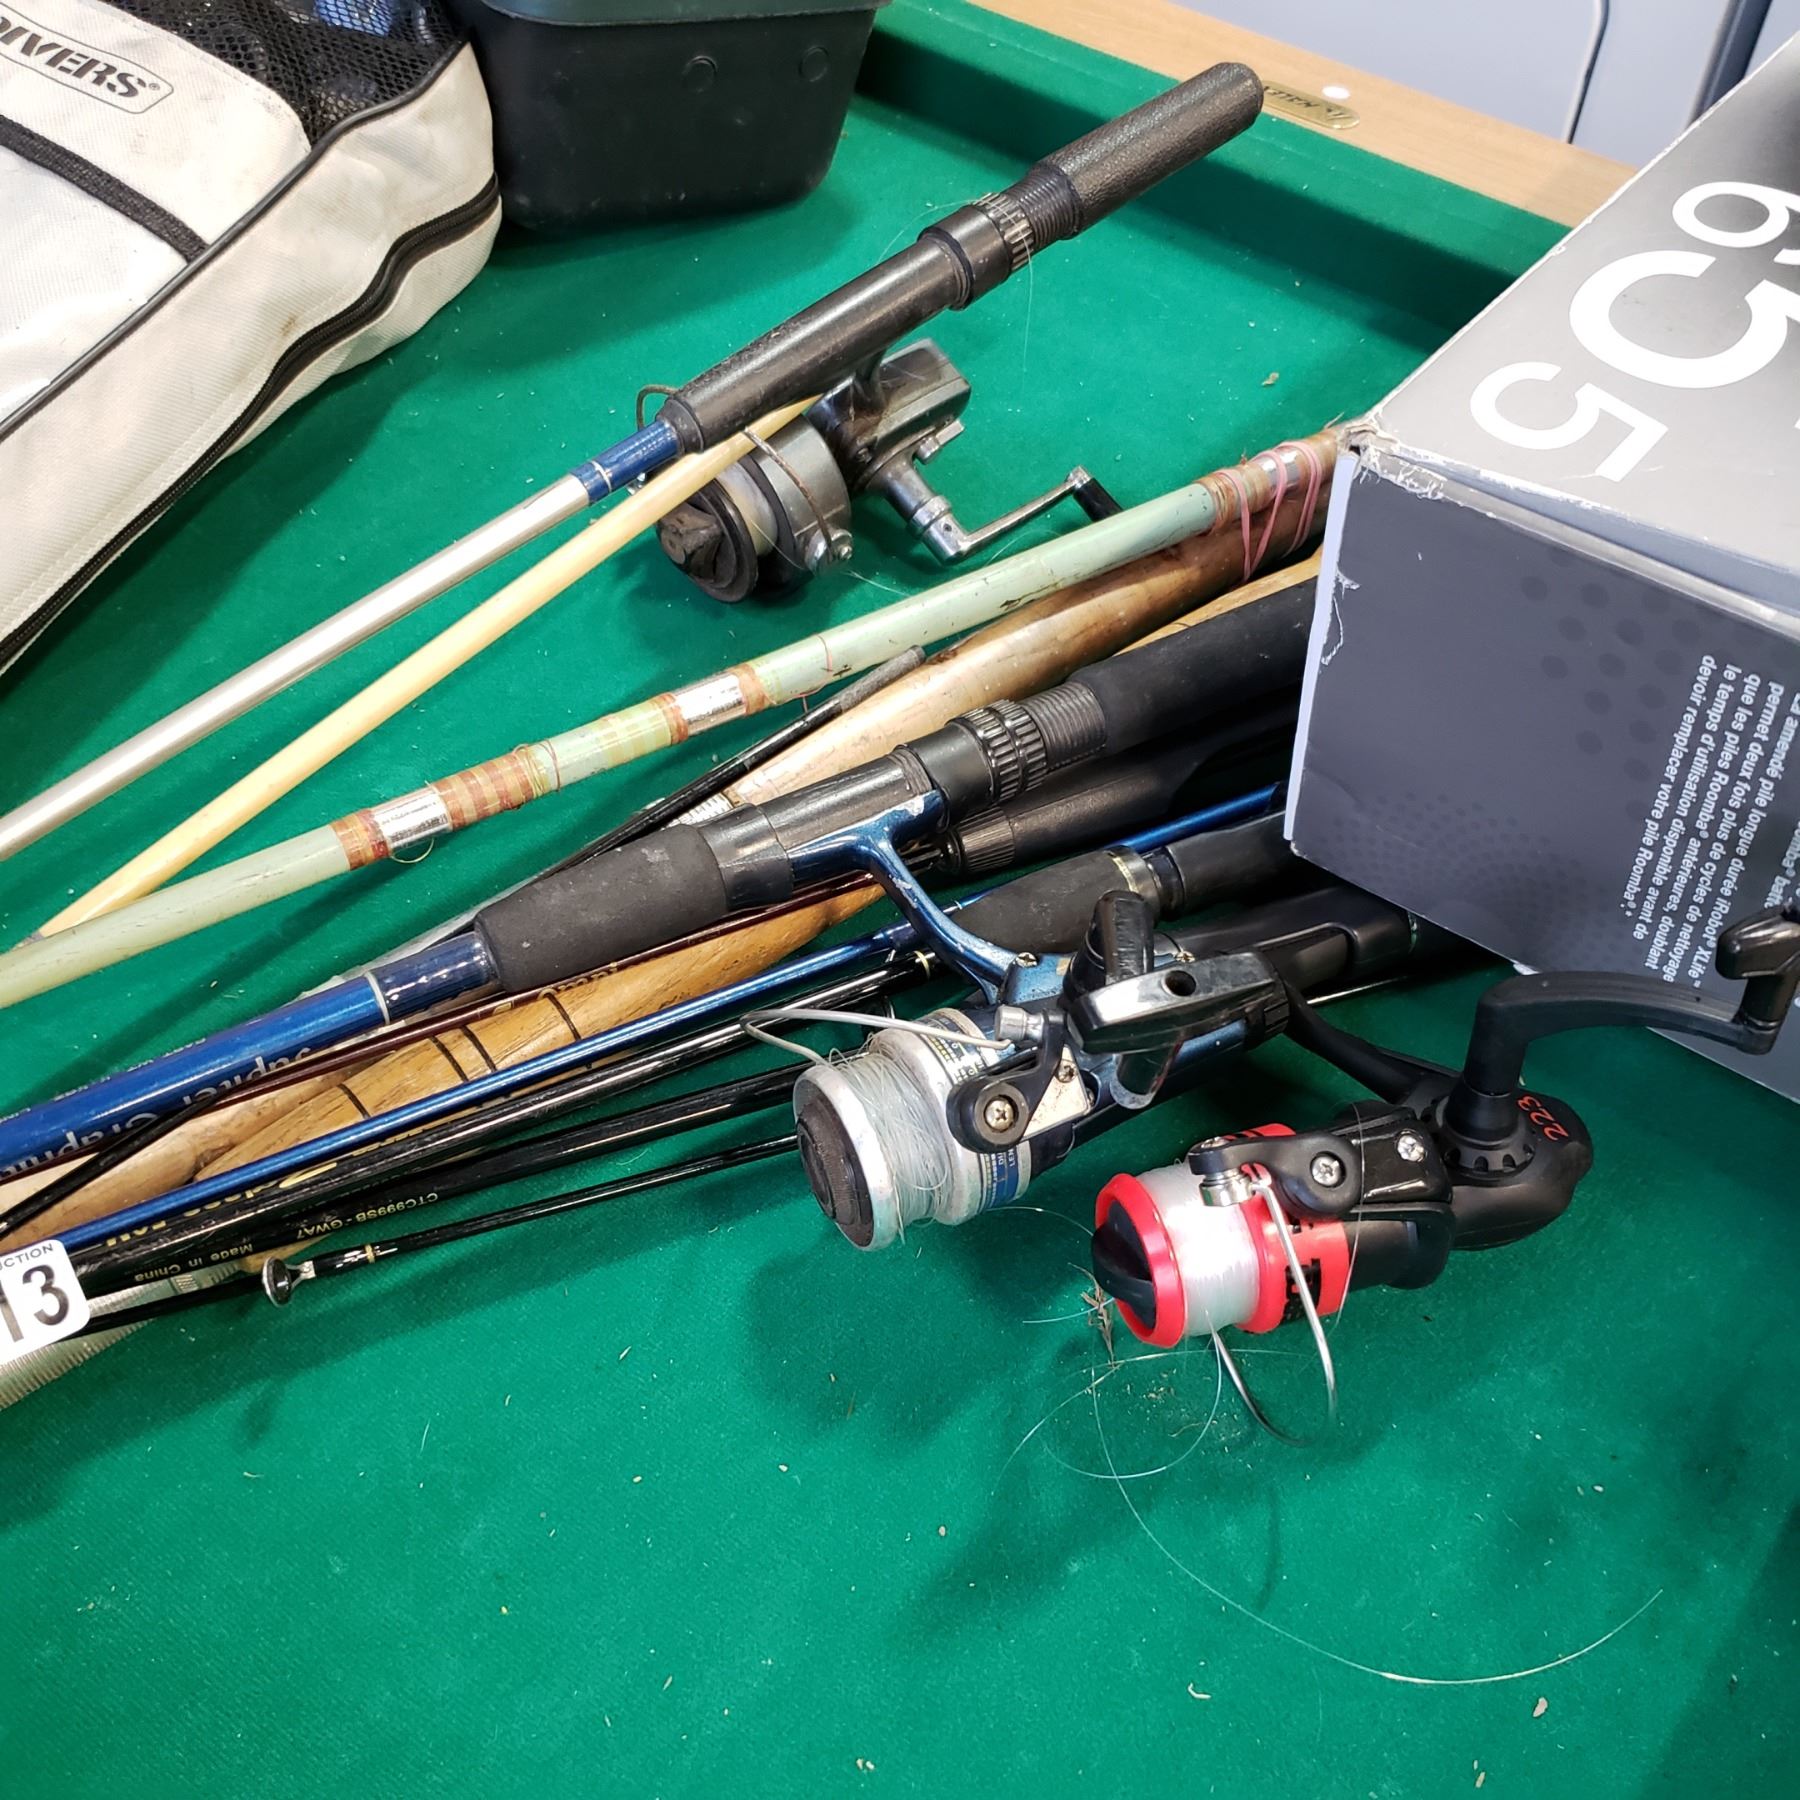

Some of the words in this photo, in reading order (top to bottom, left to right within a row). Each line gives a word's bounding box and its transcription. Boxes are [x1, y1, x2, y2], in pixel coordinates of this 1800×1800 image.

[1690, 655, 1717, 706] devoir
[1723, 664, 1742, 680] le
[1741, 674, 1761, 705] que
[1705, 683, 1734, 732] temps
[1731, 707, 1753, 731] les
[1753, 682, 1784, 741] permet
[1664, 706, 1697, 782] remplacer
[1717, 731, 1740, 769] piles
[1739, 742, 1764, 780] deux
[1766, 716, 1798, 779] amendé
[1651, 784, 1672, 819] votre
[1728, 780, 1751, 808] fois
[1755, 777, 1774, 807] pile
[1642, 819, 1660, 846] pile
[1717, 808, 1737, 840] plus
[1736, 808, 1767, 856] longue
[1652, 818, 1686, 886] disponible
[1709, 842, 1726, 860] de
[1663, 838, 1701, 912] antérieures,
[1693, 862, 1717, 904] cycles
[1720, 858, 1745, 896] durée
[1638, 887, 1659, 923] avant
[1686, 905, 1702, 922] de
[1633, 923, 1649, 939] de
[1645, 916, 1675, 969] doublant
[1662, 923, 1693, 982] nettoyage
[1517, 1096, 1569, 1140] 223
[0, 1242, 54, 1270] CTION
[188, 1257, 203, 1268] in
[210, 1243, 253, 1261] Made
[134, 1264, 181, 1281] China
